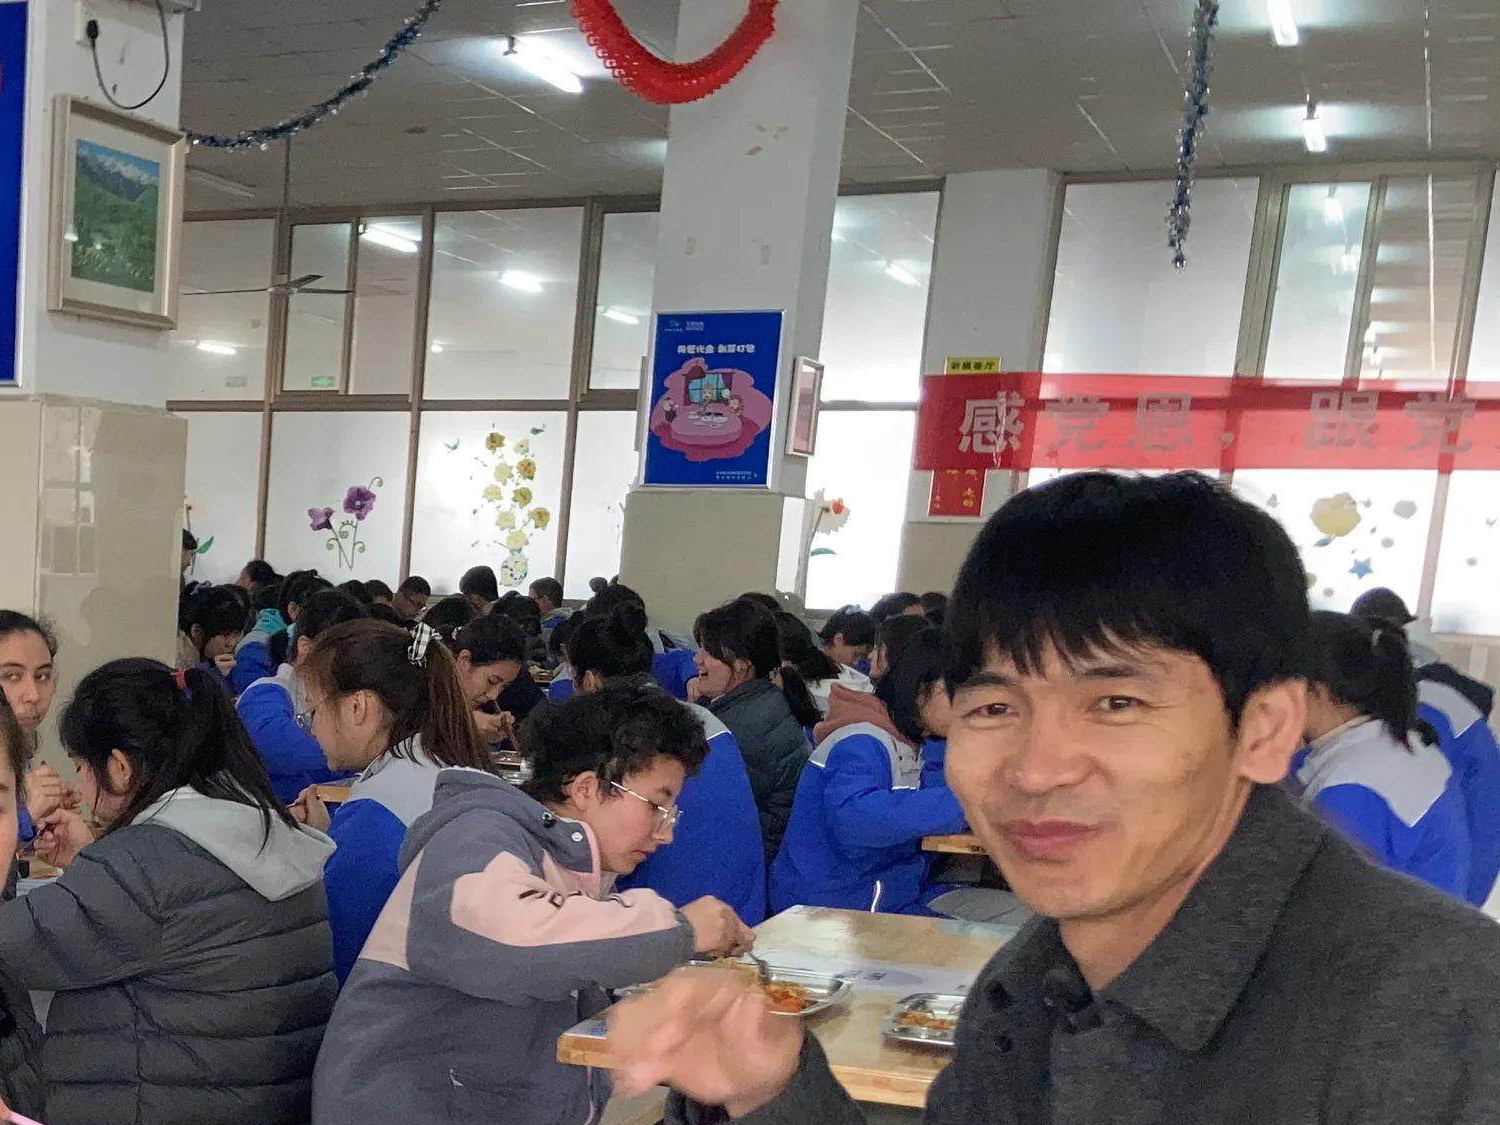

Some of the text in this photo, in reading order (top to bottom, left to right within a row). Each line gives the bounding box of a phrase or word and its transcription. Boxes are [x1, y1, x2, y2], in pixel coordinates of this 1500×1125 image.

[958, 390, 1500, 455] 感党恩，跟党
